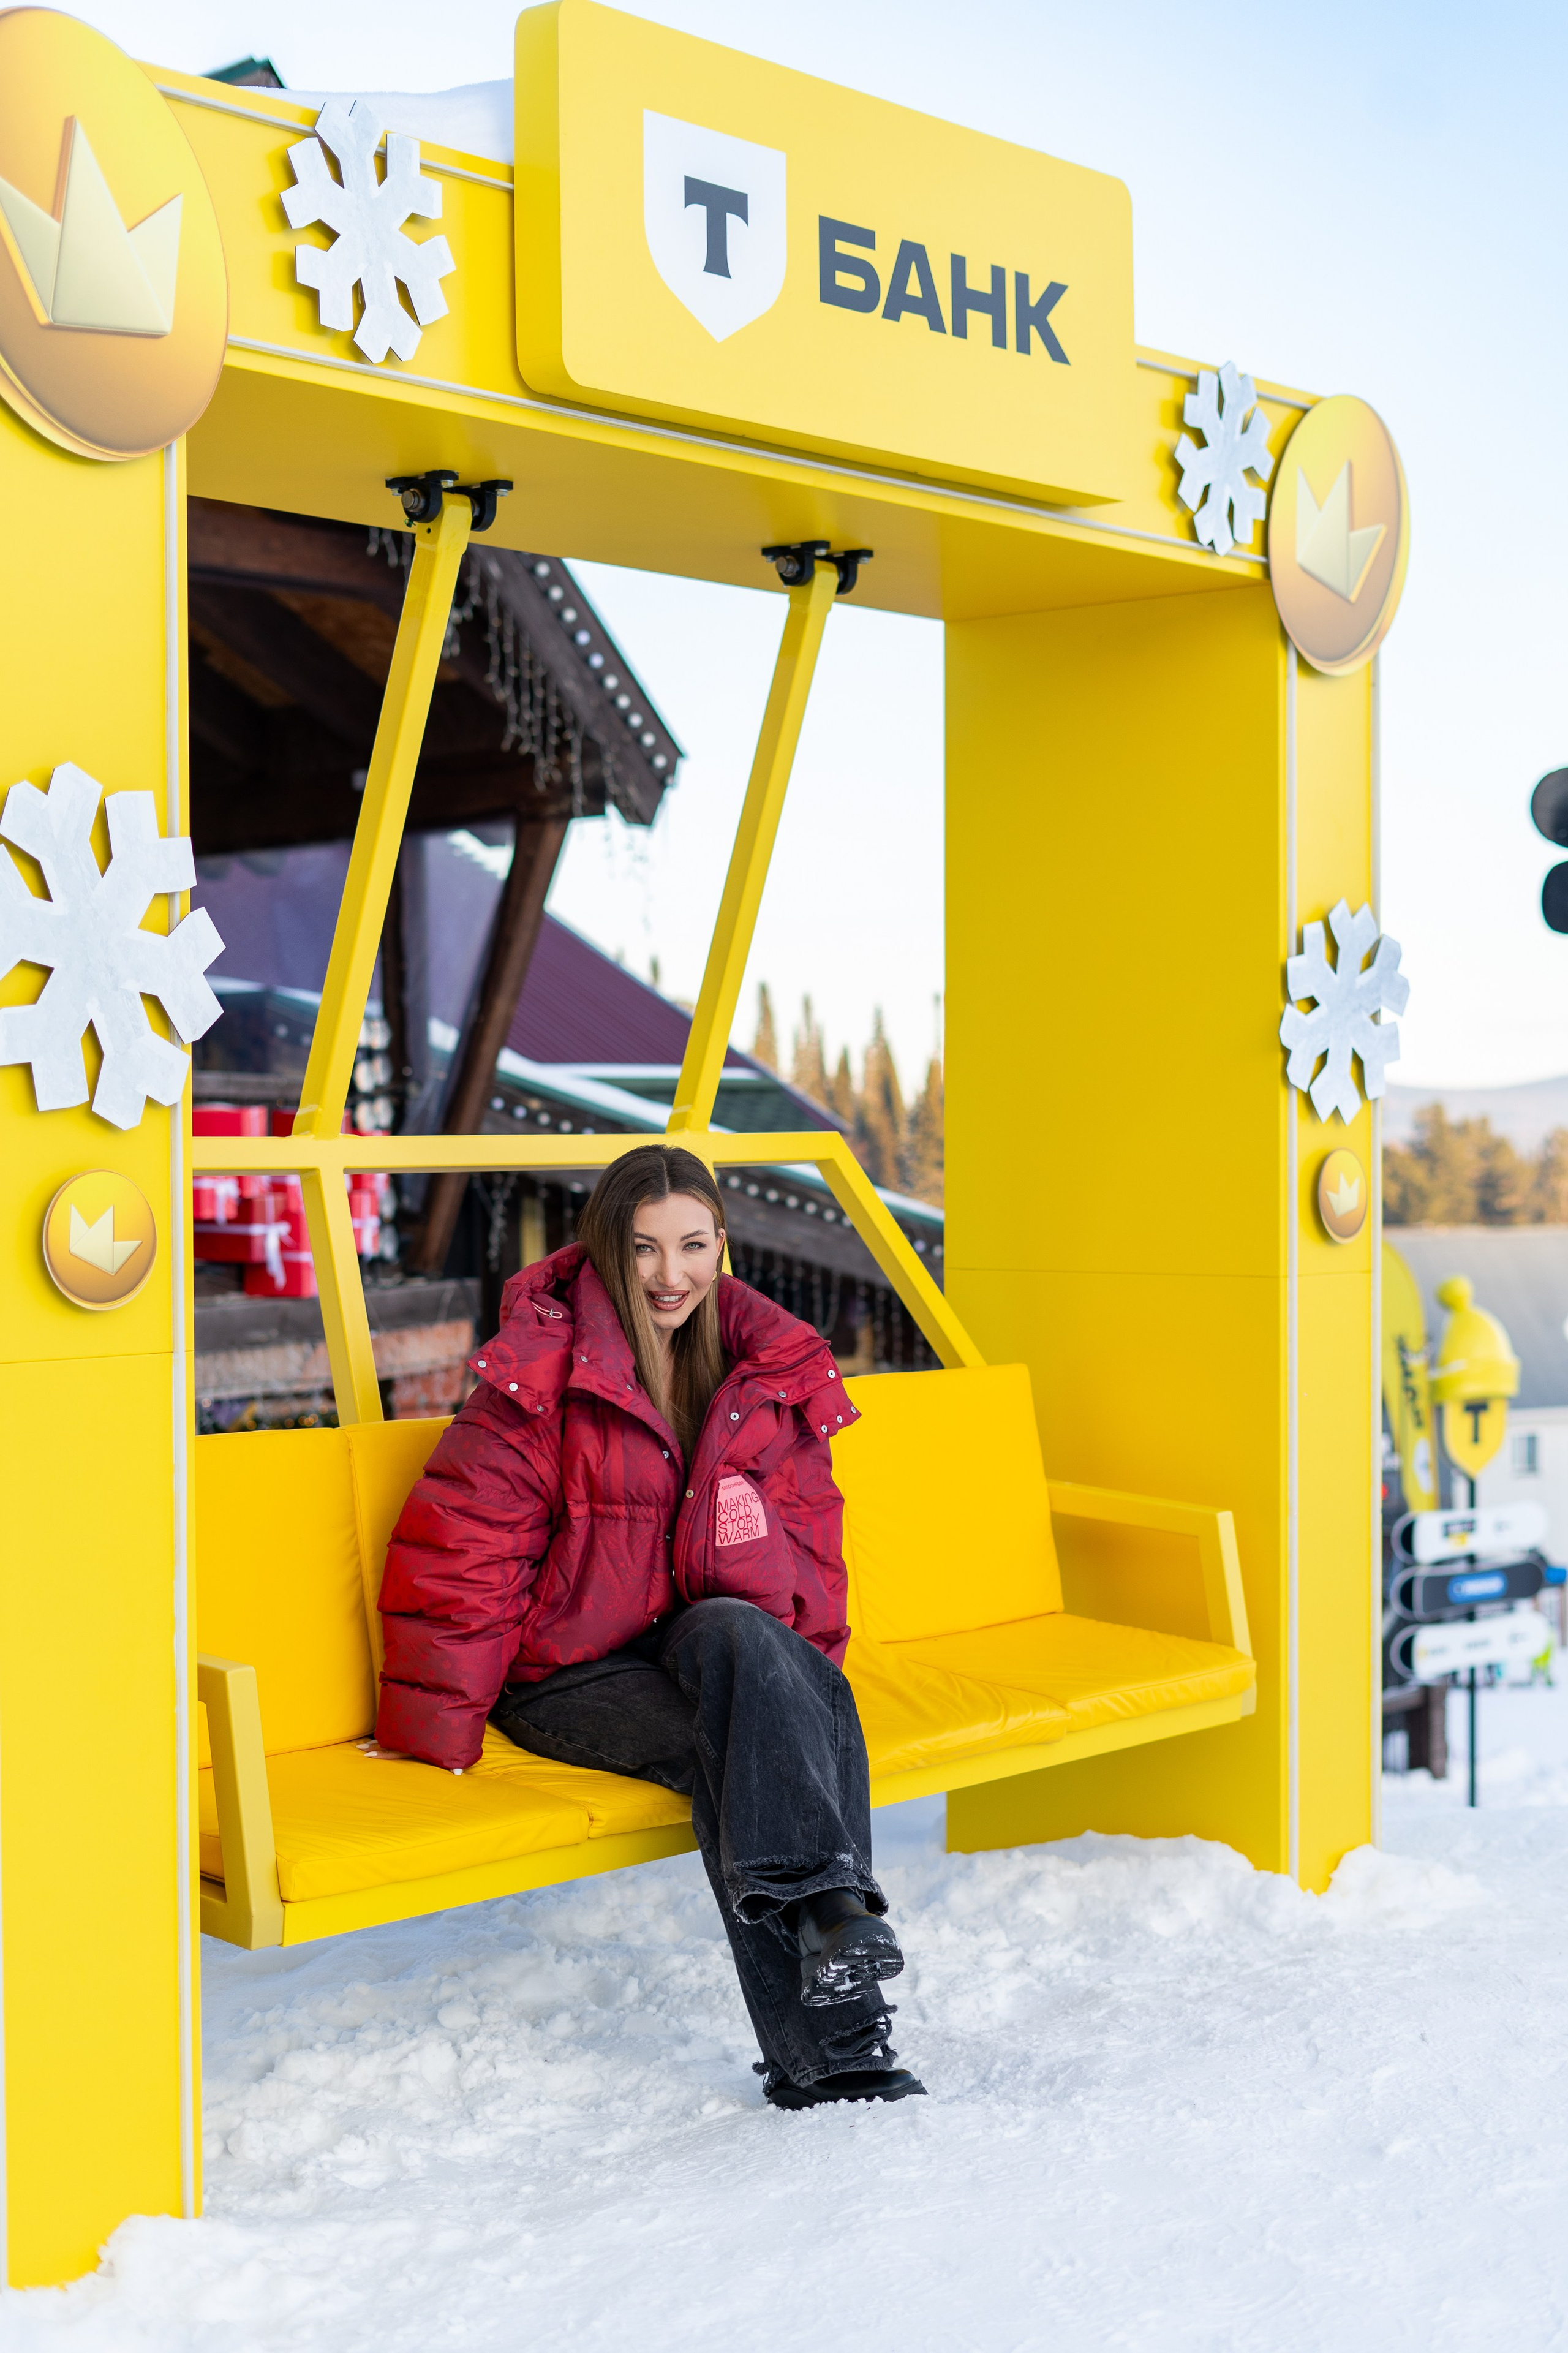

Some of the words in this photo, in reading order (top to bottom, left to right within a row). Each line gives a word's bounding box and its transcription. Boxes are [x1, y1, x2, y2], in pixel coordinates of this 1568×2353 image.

[818, 214, 1072, 366] БАНК
[718, 1505, 752, 1523] COLD
[718, 1513, 760, 1534] STORY
[718, 1525, 760, 1545] WARM
